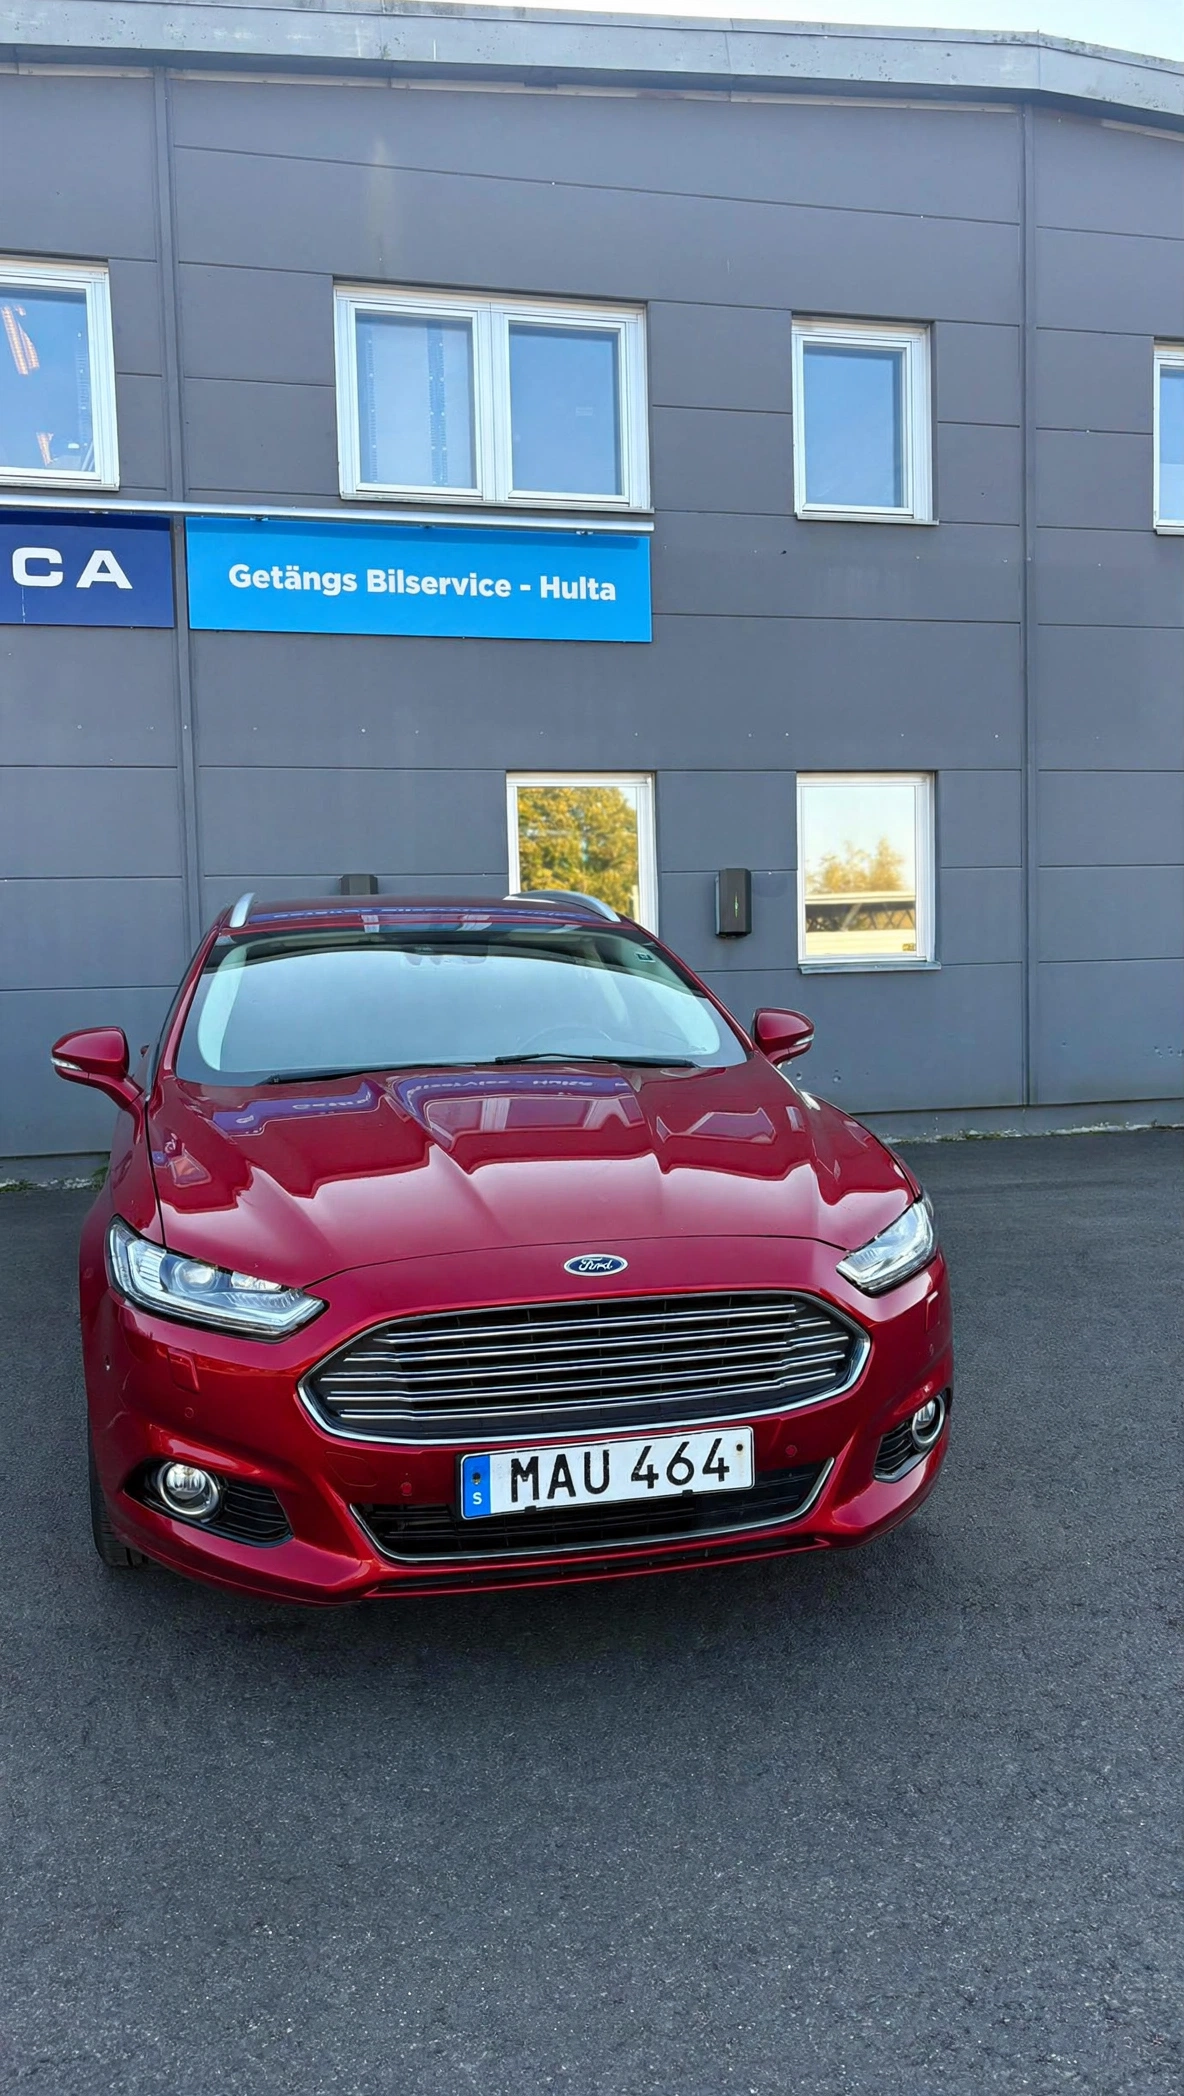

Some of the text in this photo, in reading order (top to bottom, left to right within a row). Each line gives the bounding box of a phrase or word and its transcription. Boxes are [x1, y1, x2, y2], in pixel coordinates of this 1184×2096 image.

[12, 547, 133, 589] CA
[228, 562, 358, 596] Getängs
[367, 569, 512, 598] Bilservice
[540, 575, 616, 601] Hulta
[578, 1257, 613, 1271] Ford
[510, 1437, 730, 1503] MAU 464
[472, 1491, 482, 1505] S
